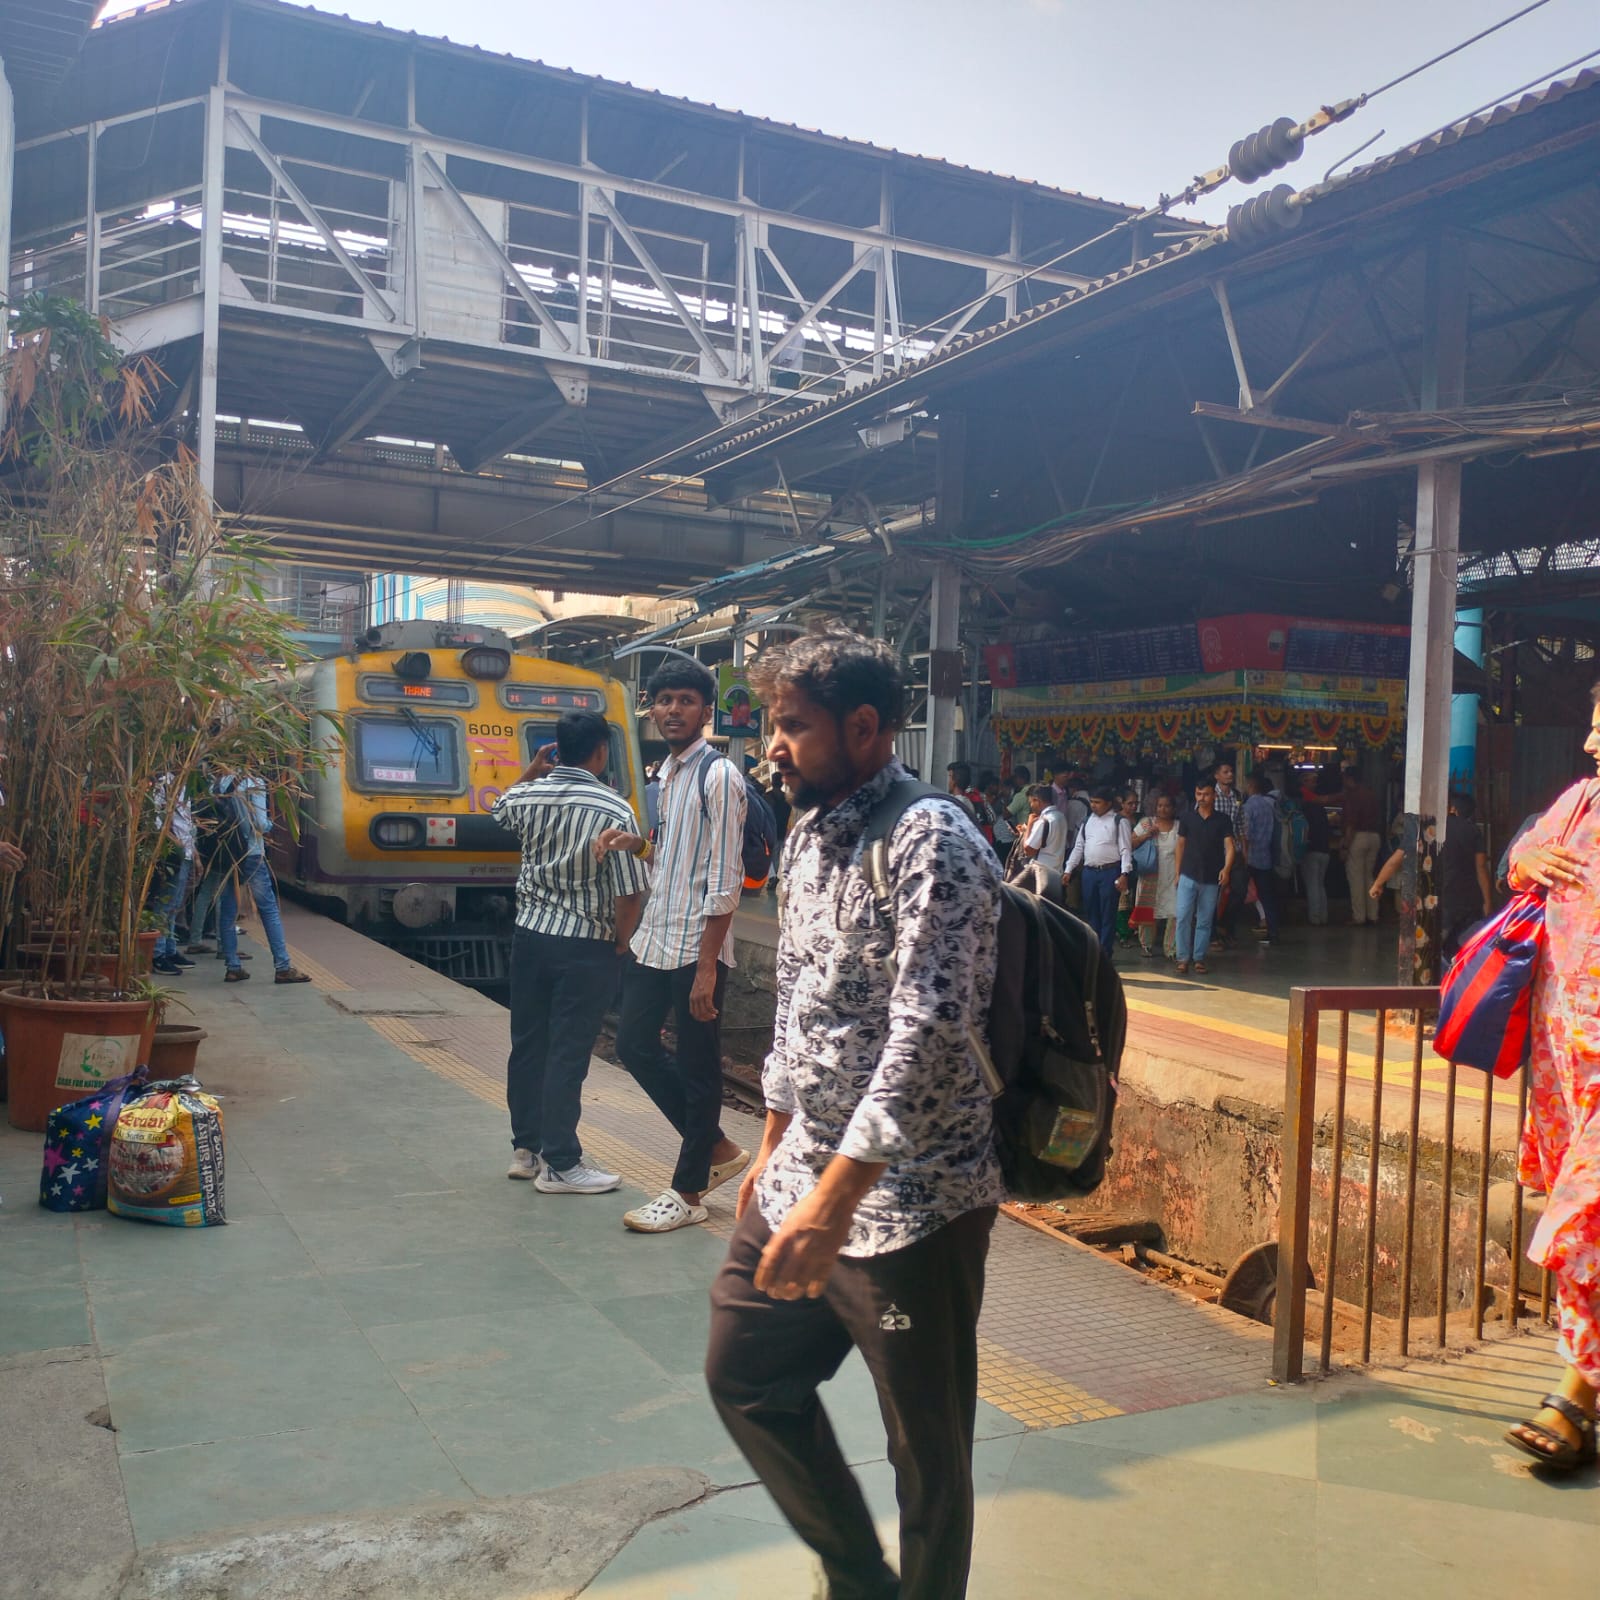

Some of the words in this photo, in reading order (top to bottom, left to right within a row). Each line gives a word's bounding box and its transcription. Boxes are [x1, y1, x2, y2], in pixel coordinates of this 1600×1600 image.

[403, 686, 432, 697] THANE
[468, 723, 514, 736] 6009
[467, 785, 503, 813] IC
